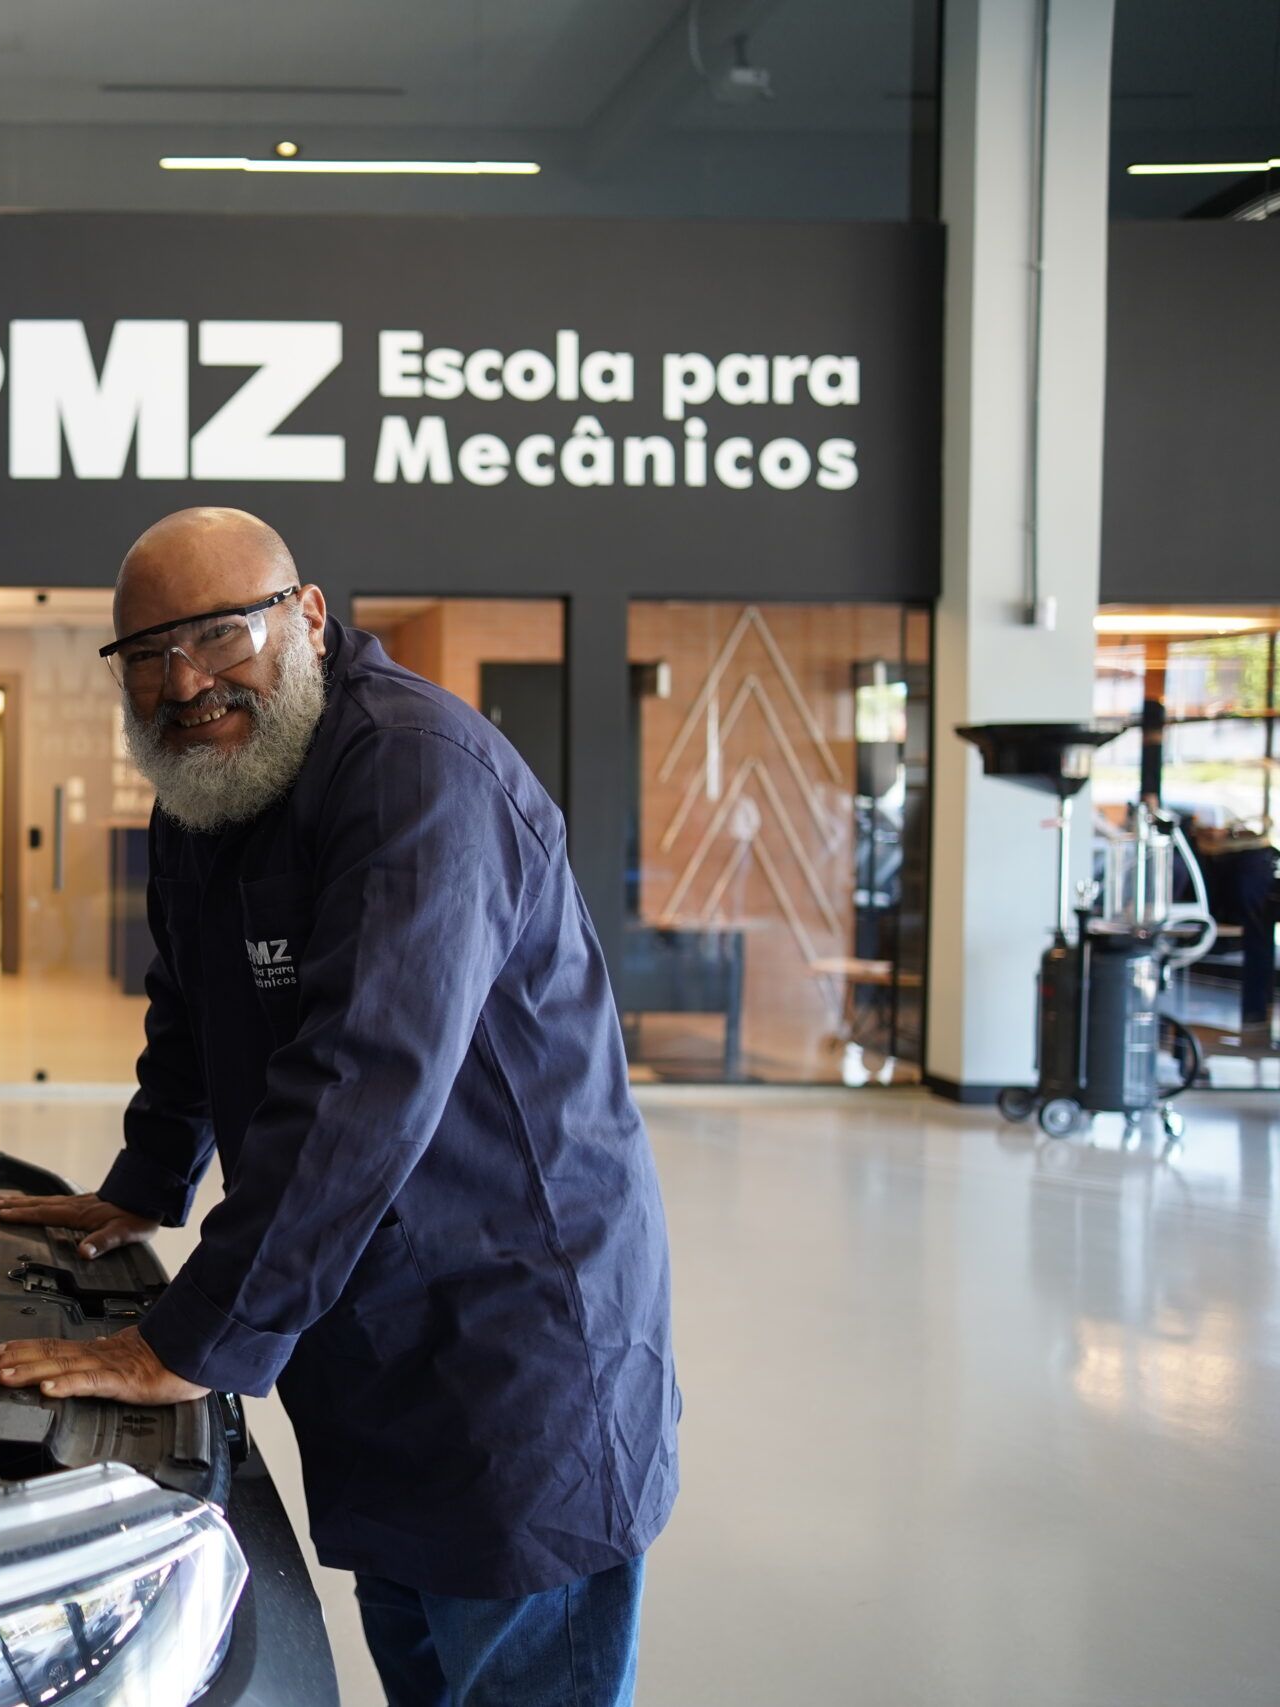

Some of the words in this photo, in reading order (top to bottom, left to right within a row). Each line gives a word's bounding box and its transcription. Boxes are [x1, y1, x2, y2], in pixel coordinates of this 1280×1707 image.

[379, 329, 634, 403] Escola
[663, 353, 860, 421] para
[374, 415, 858, 490] Mecânicos
[245, 939, 292, 965] MZ
[267, 965, 295, 978] para
